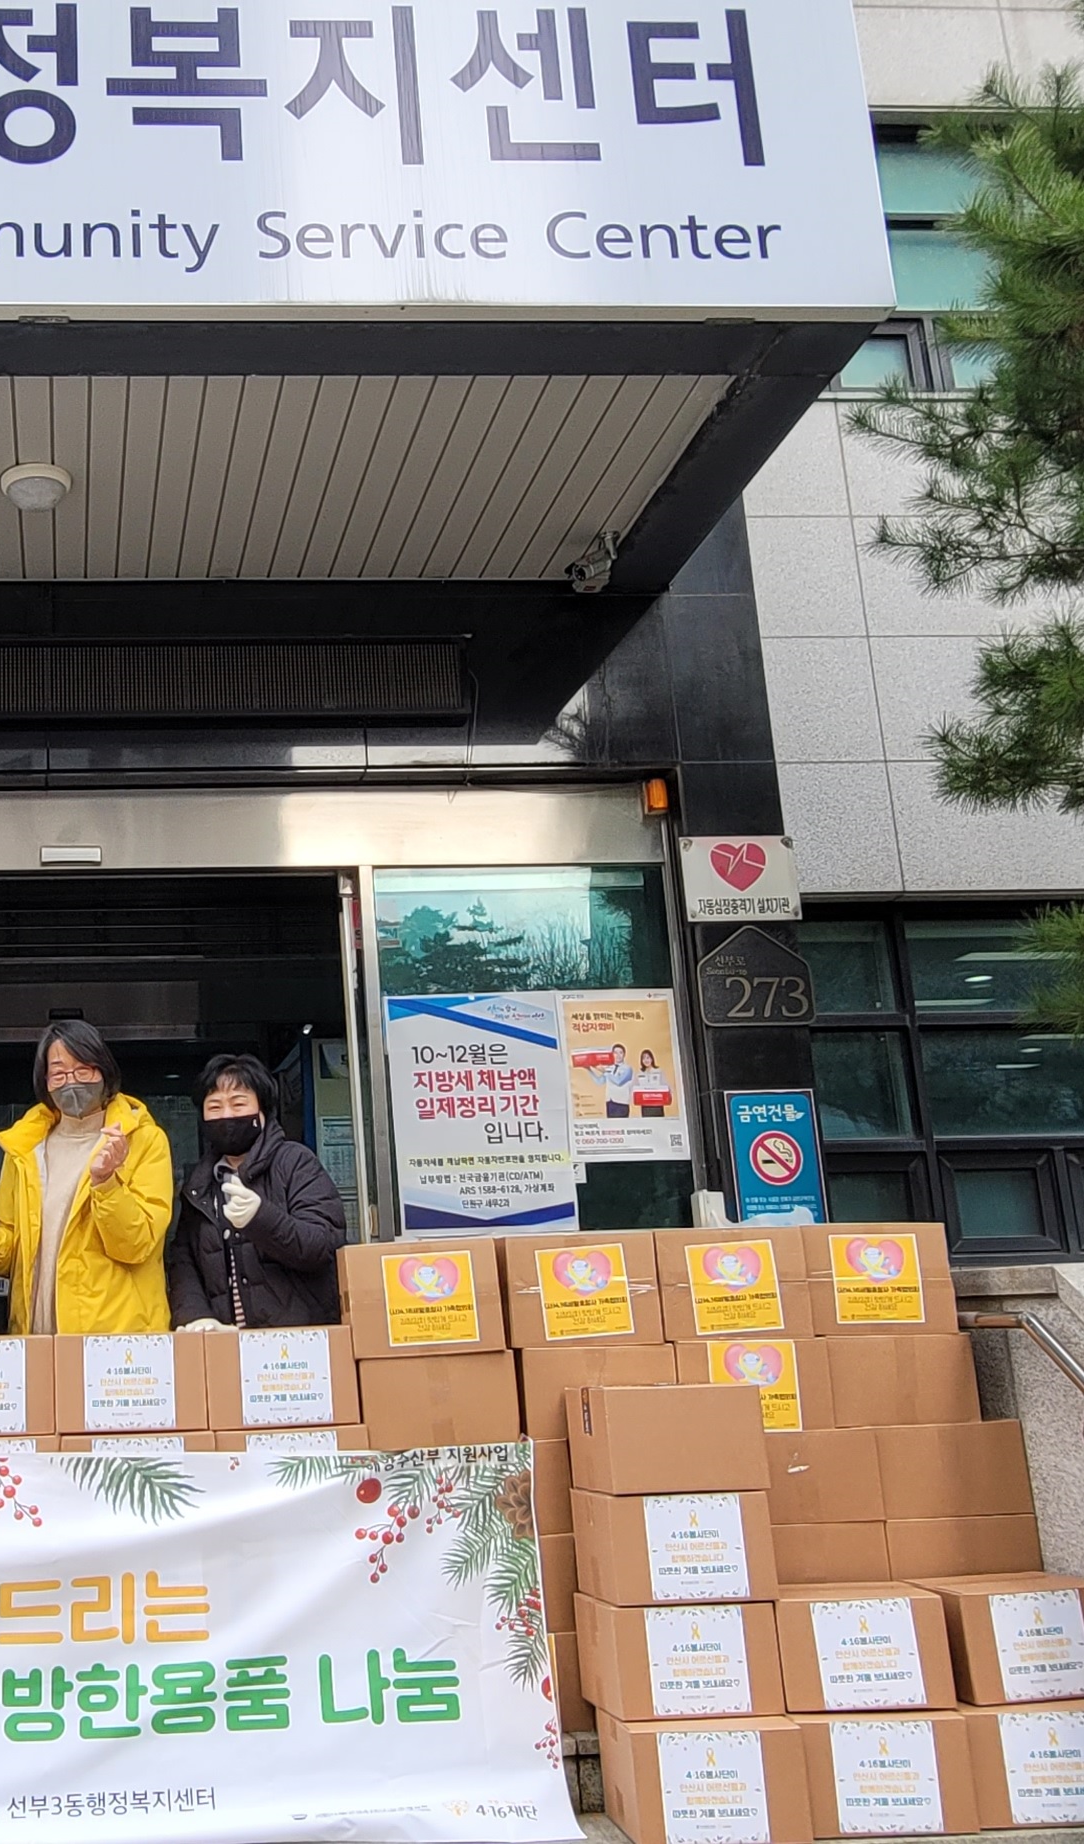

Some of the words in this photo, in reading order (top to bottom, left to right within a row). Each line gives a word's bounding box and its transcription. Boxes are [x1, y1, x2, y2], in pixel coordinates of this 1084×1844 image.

[257, 209, 508, 260] Service
[545, 212, 781, 260] Center
[698, 898, 755, 915] 자동심장충격기
[757, 897, 790, 914] 설치기관
[725, 977, 809, 1018] 273
[411, 1044, 508, 1066] 10~12월은
[413, 1070, 473, 1093] 지방세
[477, 1068, 536, 1091] 체납액
[416, 1097, 496, 1120] 일제정리
[499, 1095, 539, 1117] 기간
[737, 1105, 797, 1123] 금연건물
[484, 1121, 549, 1144] 입니다.
[459, 1186, 476, 1195] ARS
[447, 1445, 508, 1463] 지원사업
[1, 1654, 291, 1743] 방한용품
[318, 1646, 461, 1726] 나눔
[6, 1786, 216, 1819] 선부3동행정복지센터
[476, 1803, 538, 1821] 4·16재단
